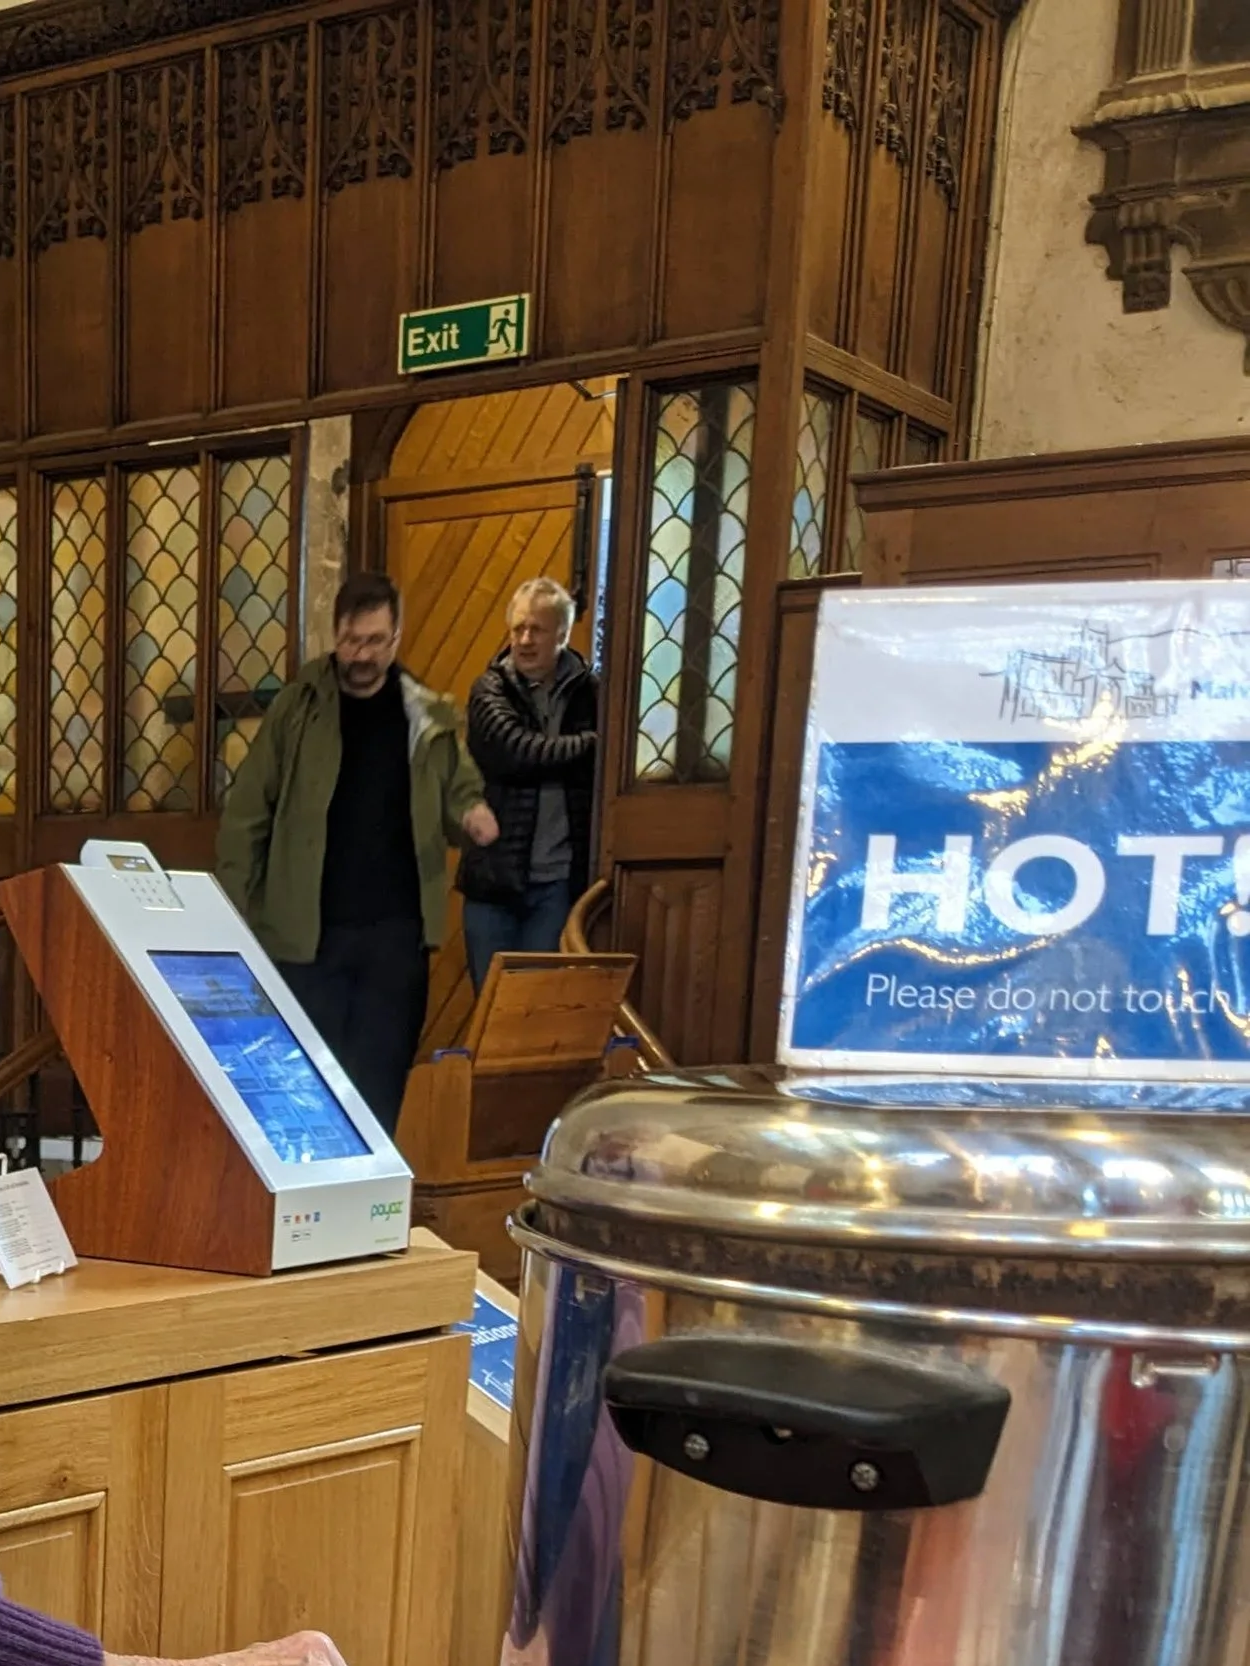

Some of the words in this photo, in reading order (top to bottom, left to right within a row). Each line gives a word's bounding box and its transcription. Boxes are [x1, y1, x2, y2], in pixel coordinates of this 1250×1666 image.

[407, 322, 460, 357] Exit
[860, 834, 1250, 937] HOT!
[865, 973, 976, 1010] Please
[987, 978, 1036, 1011] do
[1050, 983, 1111, 1013] not
[1123, 978, 1231, 1015] touch
